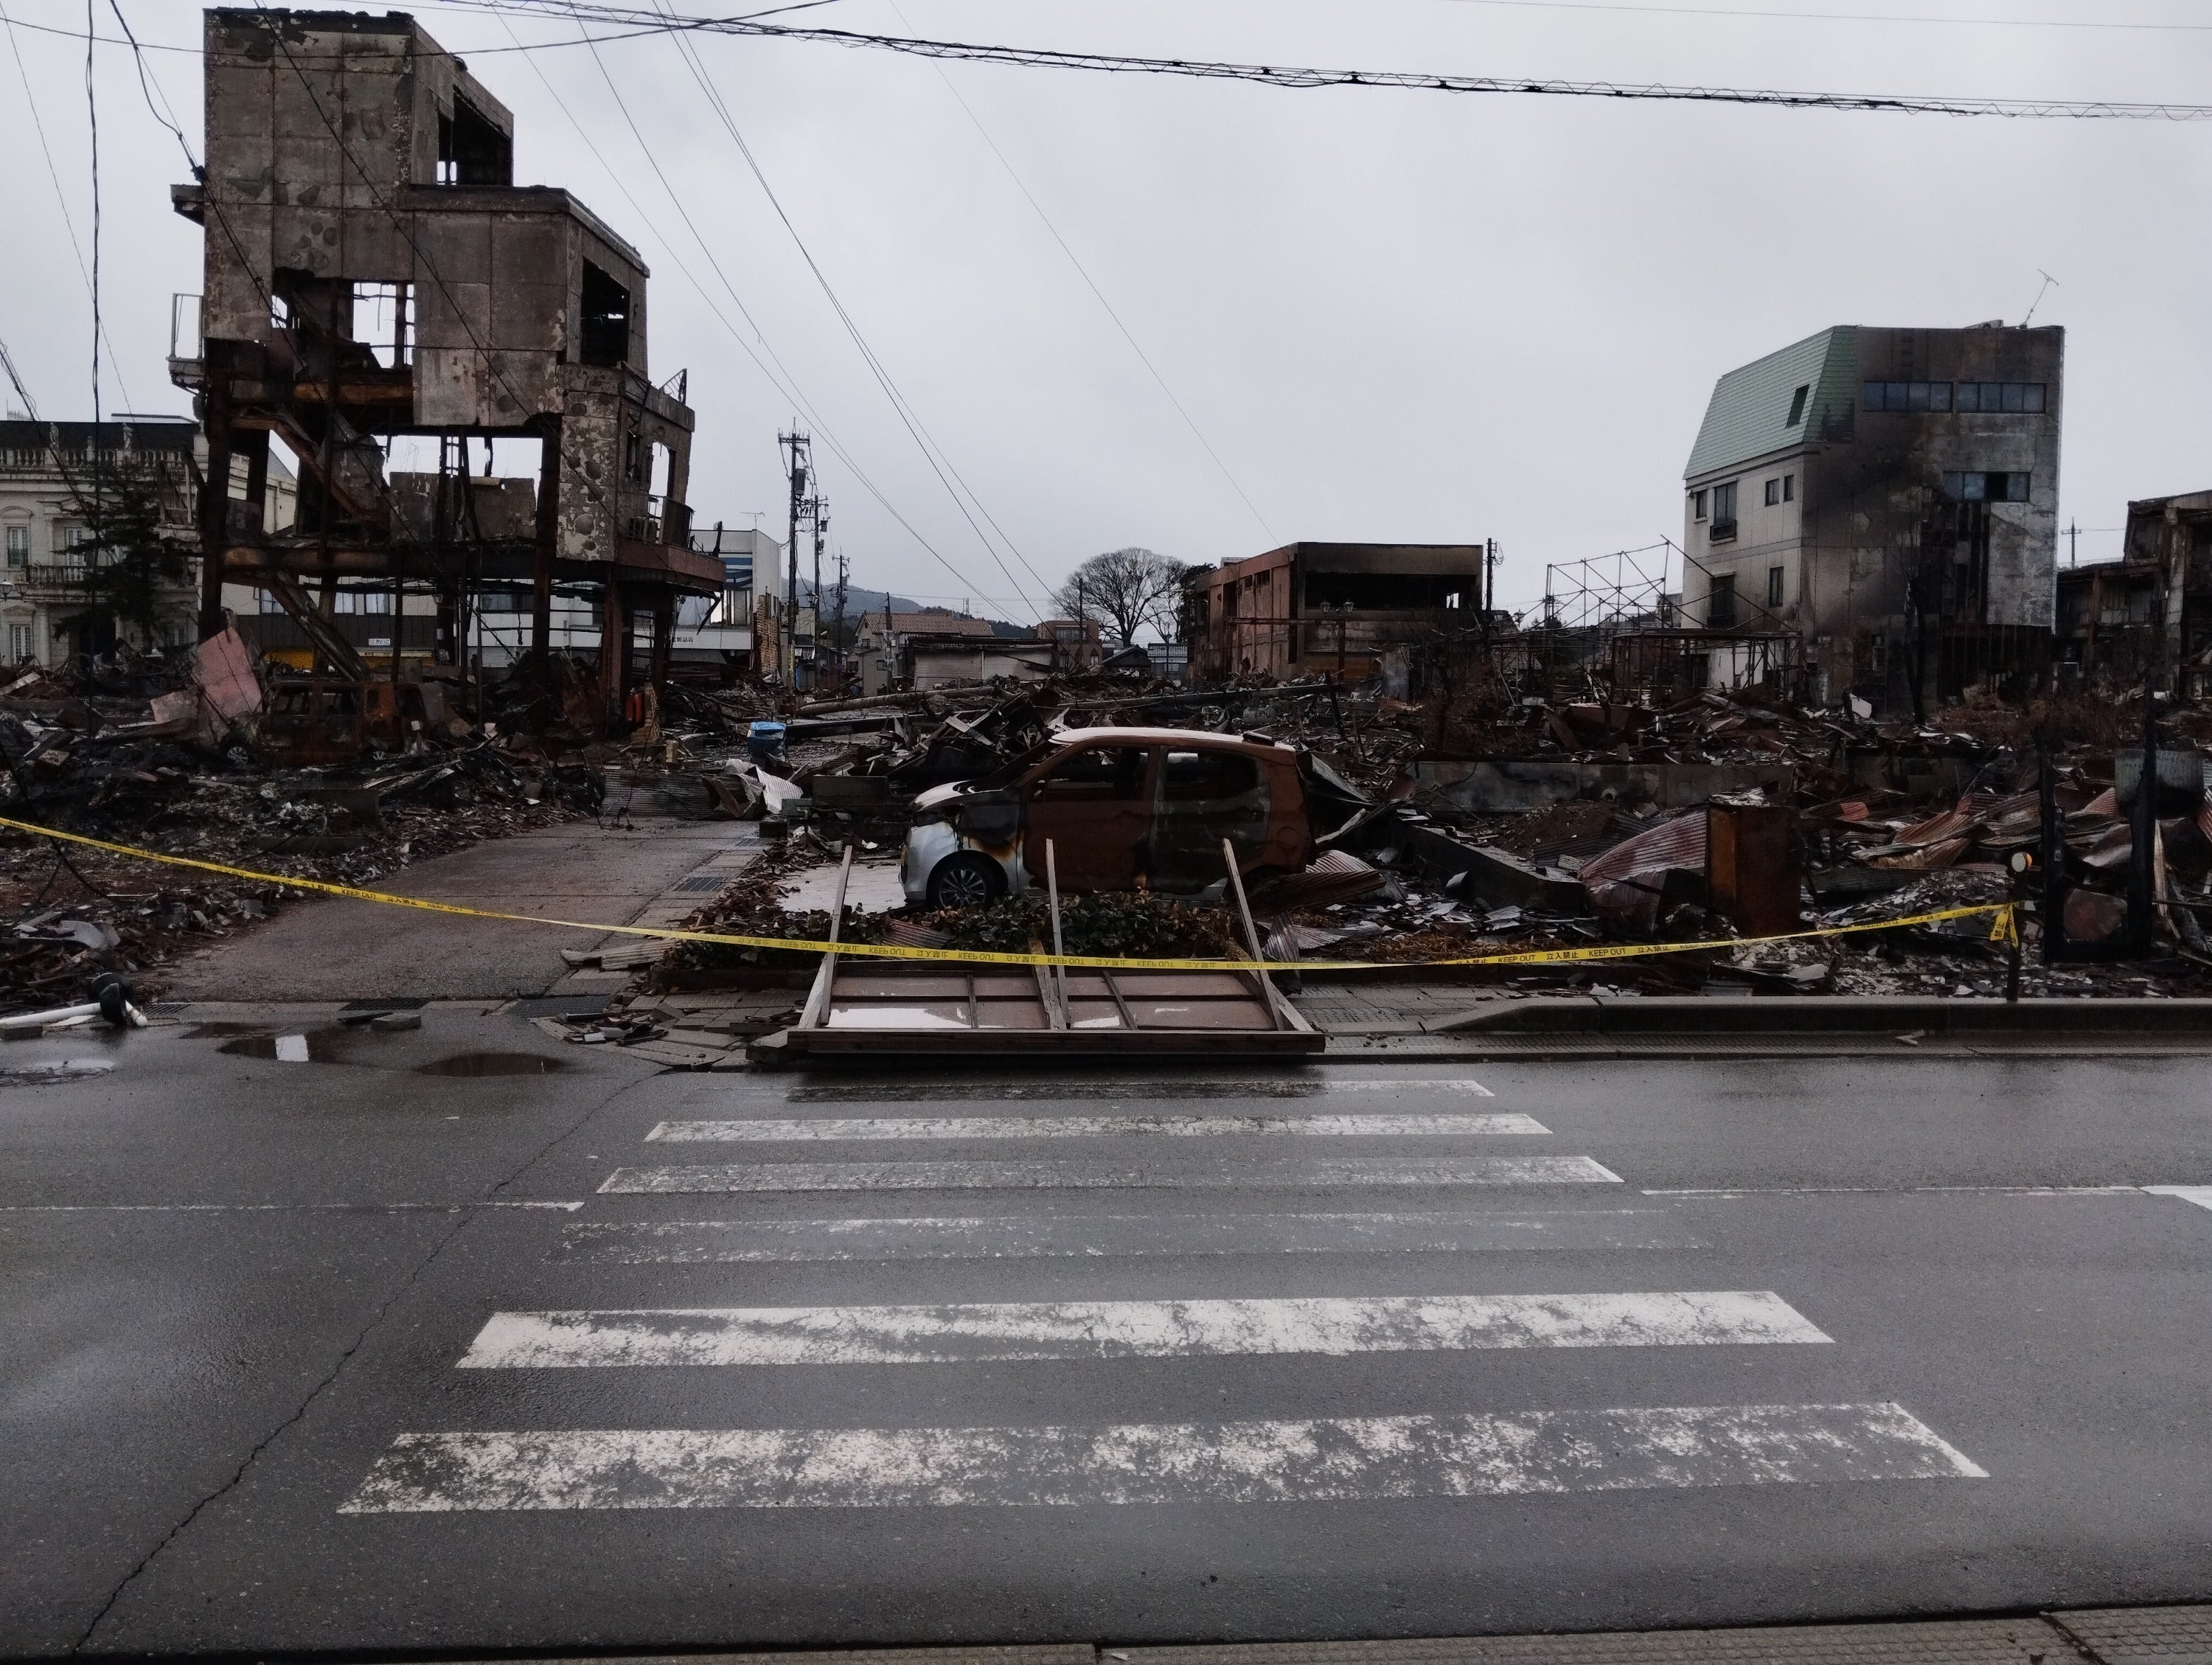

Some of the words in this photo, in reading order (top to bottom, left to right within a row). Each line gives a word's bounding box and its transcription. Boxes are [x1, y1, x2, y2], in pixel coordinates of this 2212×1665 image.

[1519, 954, 1537, 962] OUT
[1546, 951, 1579, 961] 立入禁止
[1588, 948, 1609, 957] KEEP
[1610, 948, 1627, 956] OUT
[1637, 945, 1670, 954] 立入禁止
